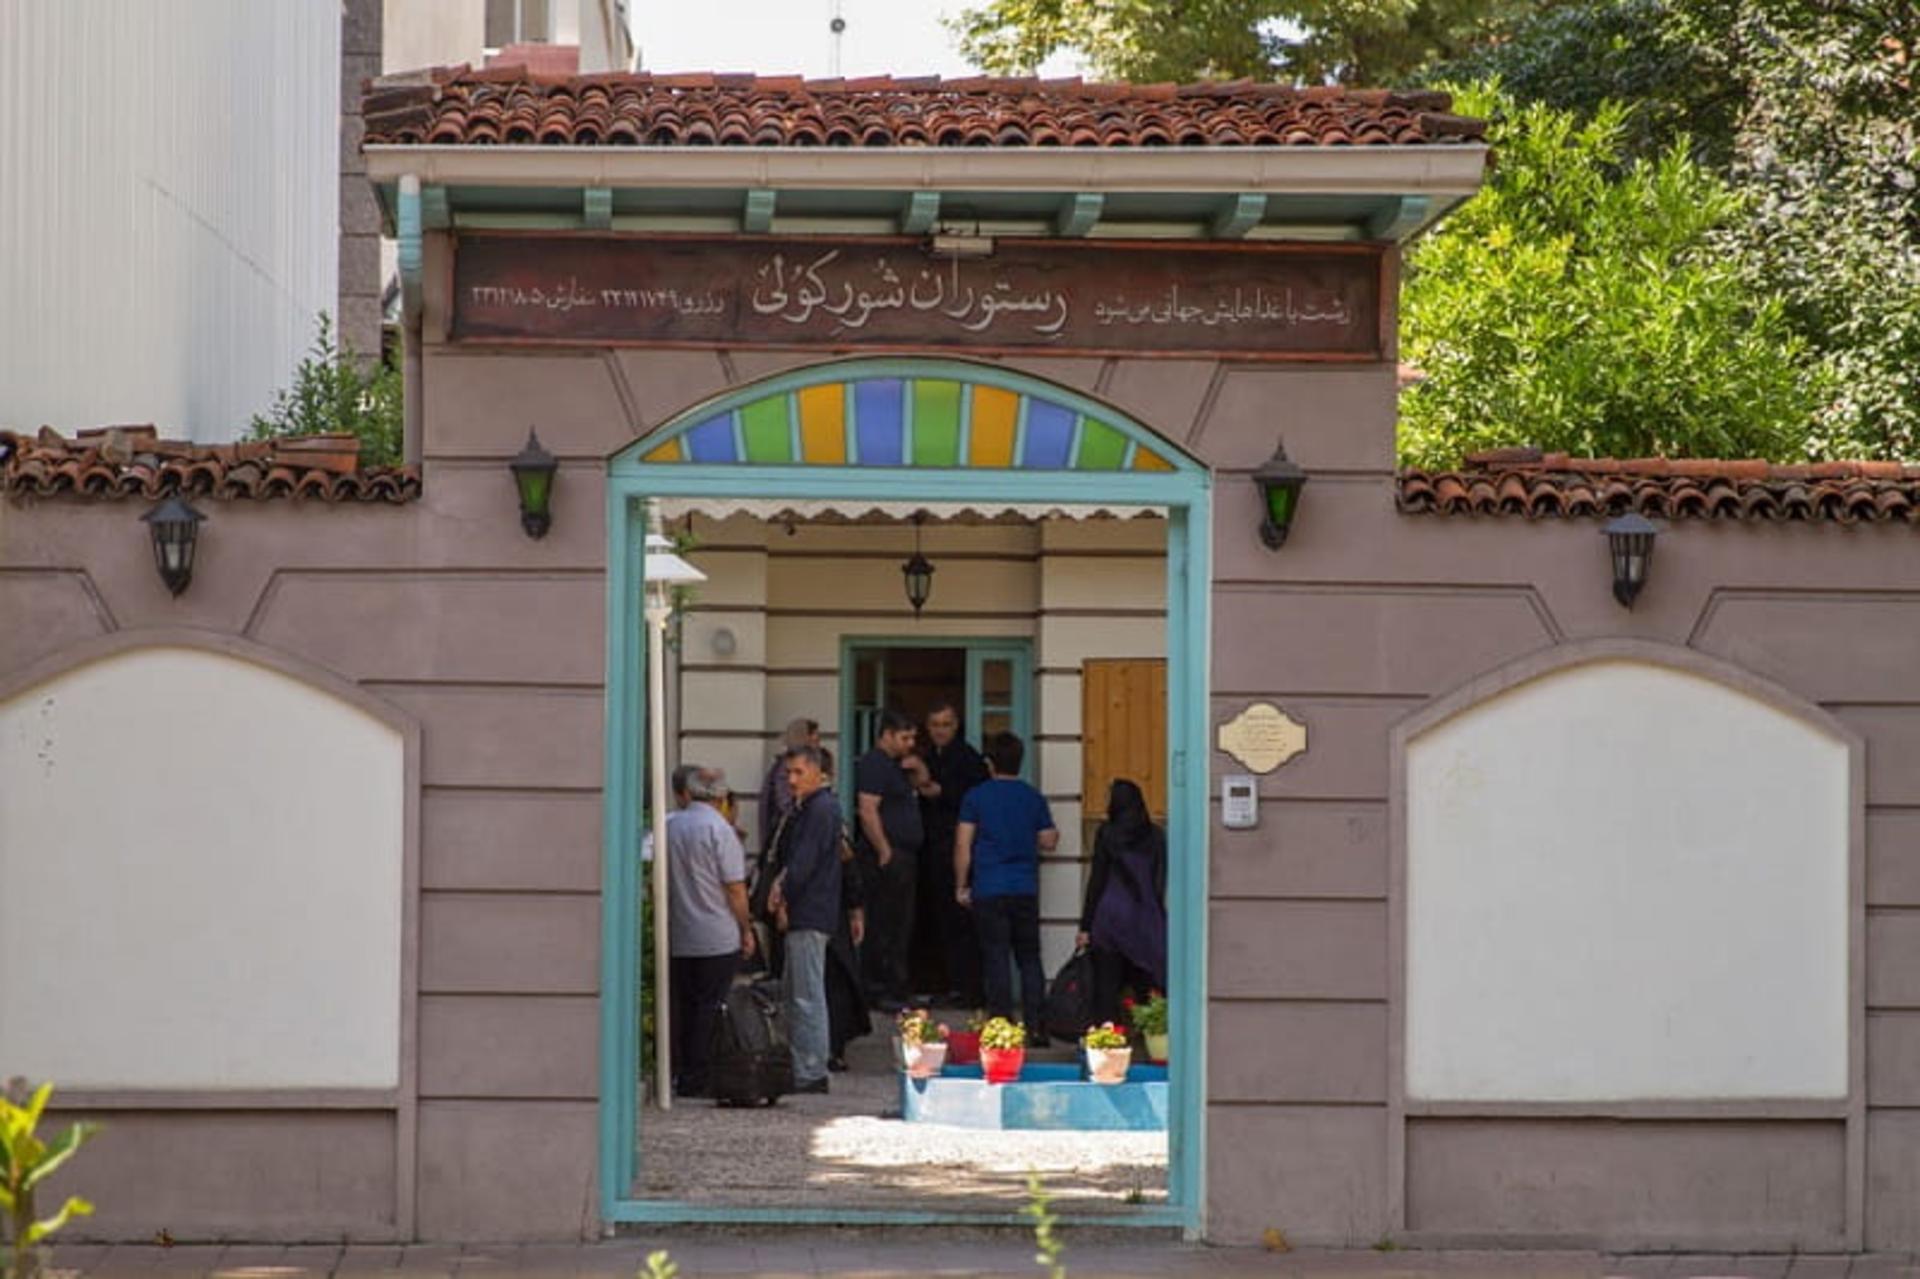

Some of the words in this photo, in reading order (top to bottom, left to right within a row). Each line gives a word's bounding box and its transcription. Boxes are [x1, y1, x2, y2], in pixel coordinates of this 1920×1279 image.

[547, 276, 596, 312] سفارش
[1151, 284, 1204, 324] جهانی
[1286, 288, 1299, 325] با
[1300, 297, 1351, 325] رشت
